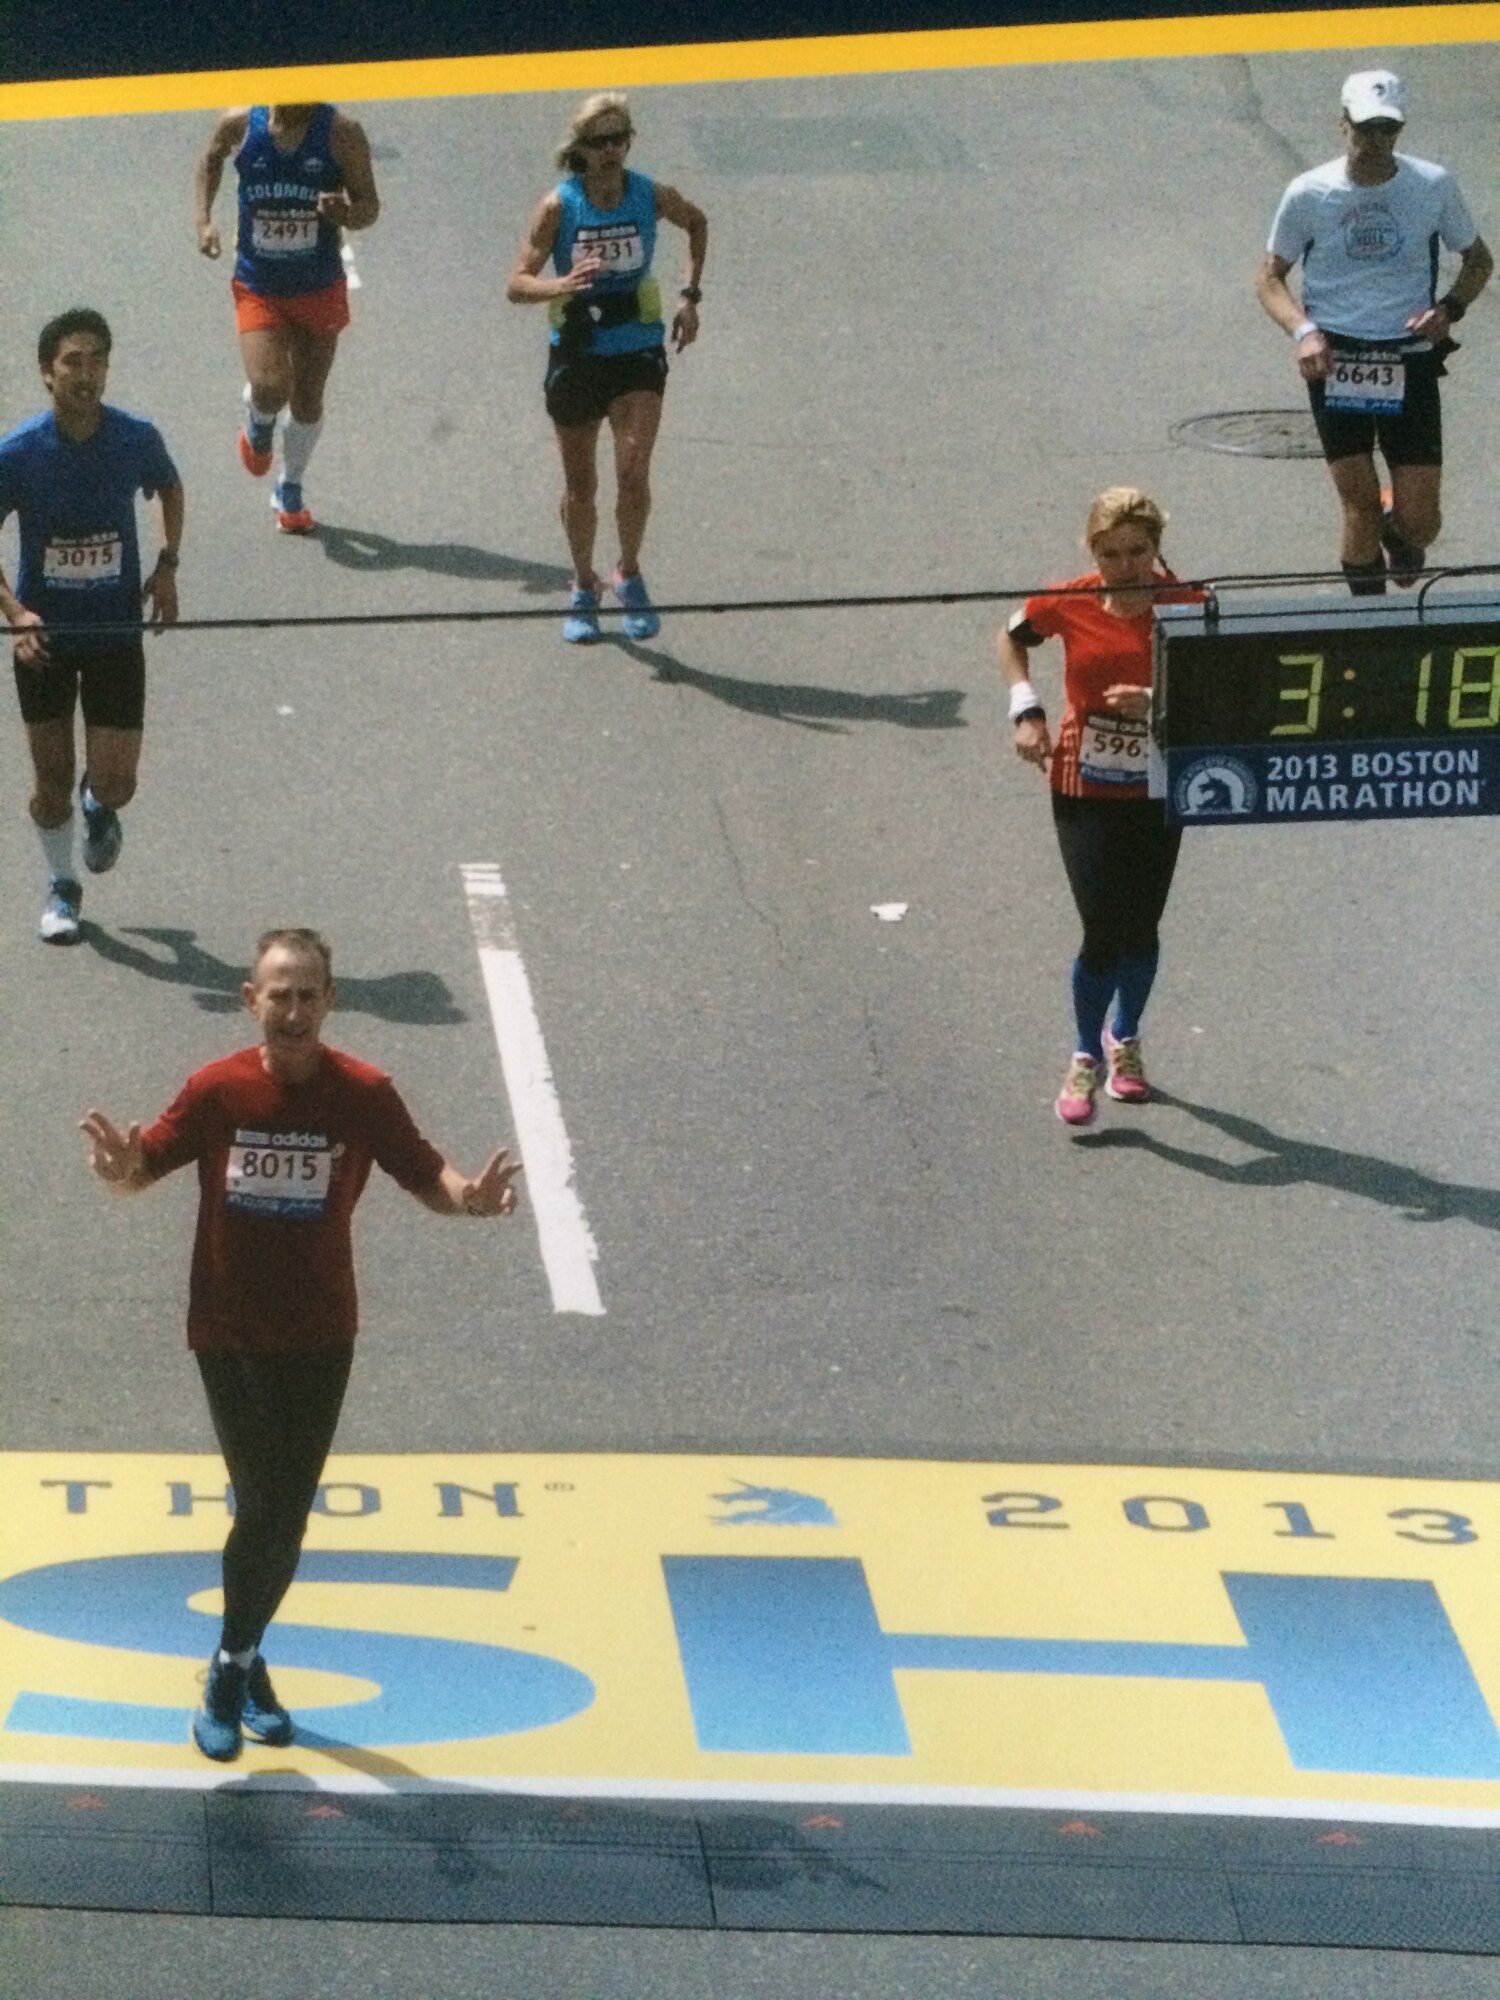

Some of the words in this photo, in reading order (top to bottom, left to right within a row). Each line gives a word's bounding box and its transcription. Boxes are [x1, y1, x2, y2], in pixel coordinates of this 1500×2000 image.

[262, 222, 310, 239] 2491
[1336, 364, 1394, 386] 6643
[57, 546, 114, 567] 3015
[1270, 647, 1500, 736] 3:18
[1266, 755, 1338, 781] 2013
[1351, 749, 1479, 778] BOSTON
[1266, 780, 1480, 812] MARATHON
[271, 1132, 328, 1148] adidas
[242, 1151, 317, 1180] 8015
[981, 1491, 1479, 1545] 2013
